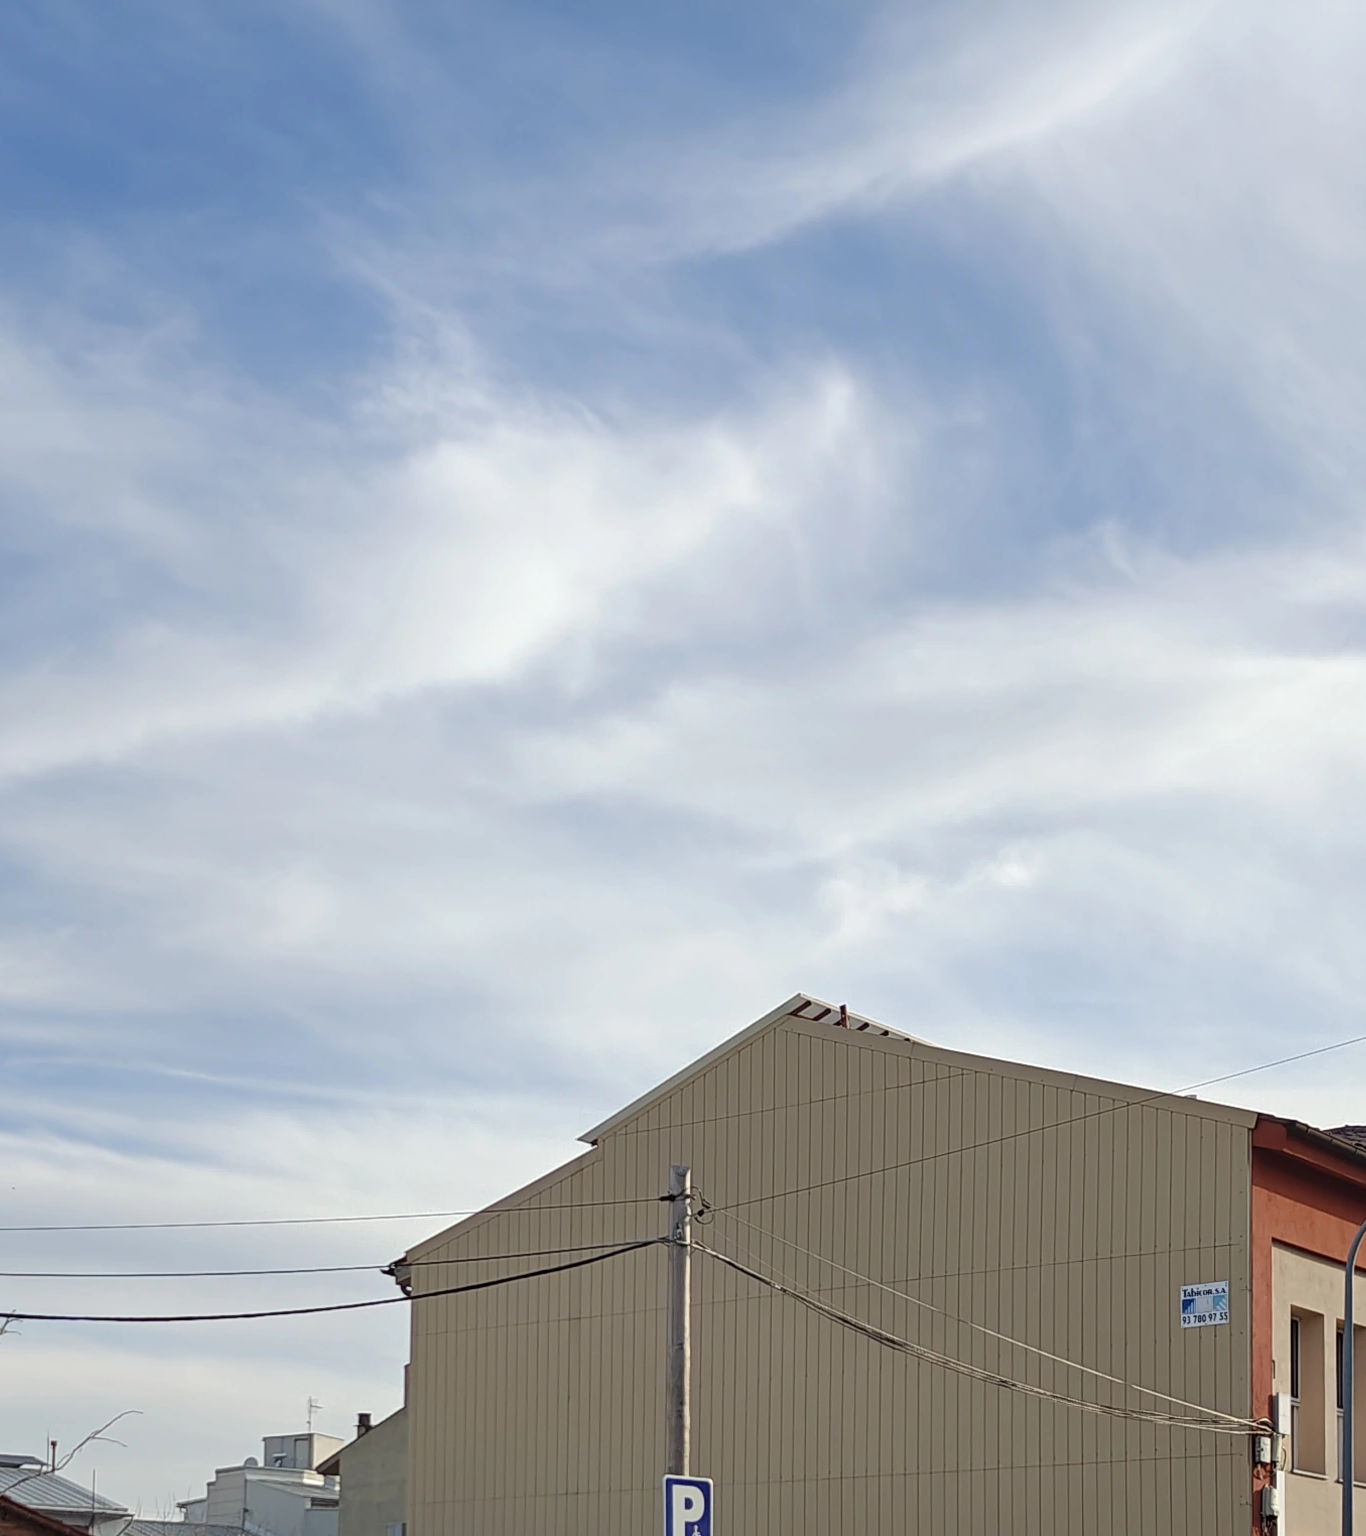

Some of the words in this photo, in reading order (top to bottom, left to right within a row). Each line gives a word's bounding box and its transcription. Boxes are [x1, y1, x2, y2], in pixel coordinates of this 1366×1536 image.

[1182, 1315, 1191, 1325] 93
[1193, 1314, 1207, 1323] 780
[1208, 1312, 1217, 1322] 97
[1219, 1311, 1228, 1321] 55
